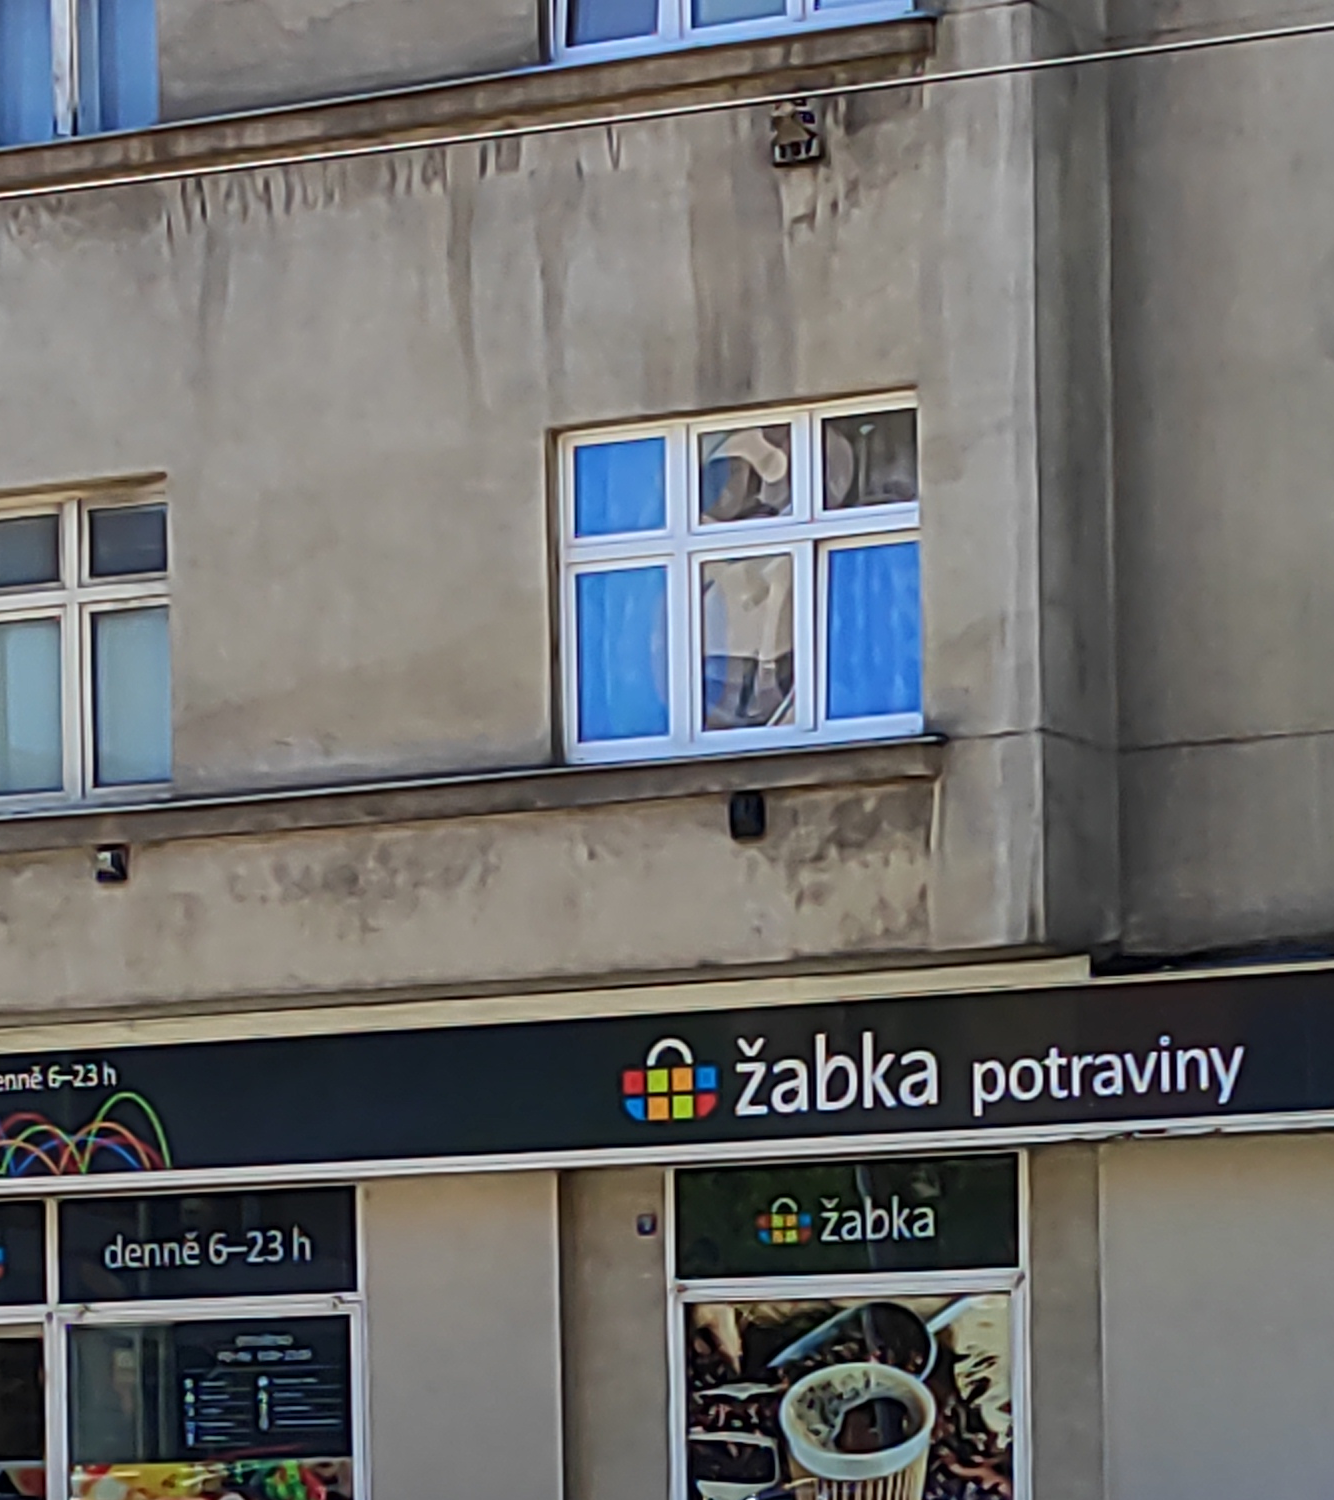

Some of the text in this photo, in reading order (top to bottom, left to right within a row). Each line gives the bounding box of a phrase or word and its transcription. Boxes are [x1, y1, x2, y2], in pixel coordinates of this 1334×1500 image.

[102, 1060, 117, 1087] h
[733, 1030, 1245, 1117] žabka potraviny
[819, 1195, 936, 1243] žabka
[103, 1231, 202, 1269] denně
[291, 1223, 313, 1262] h
